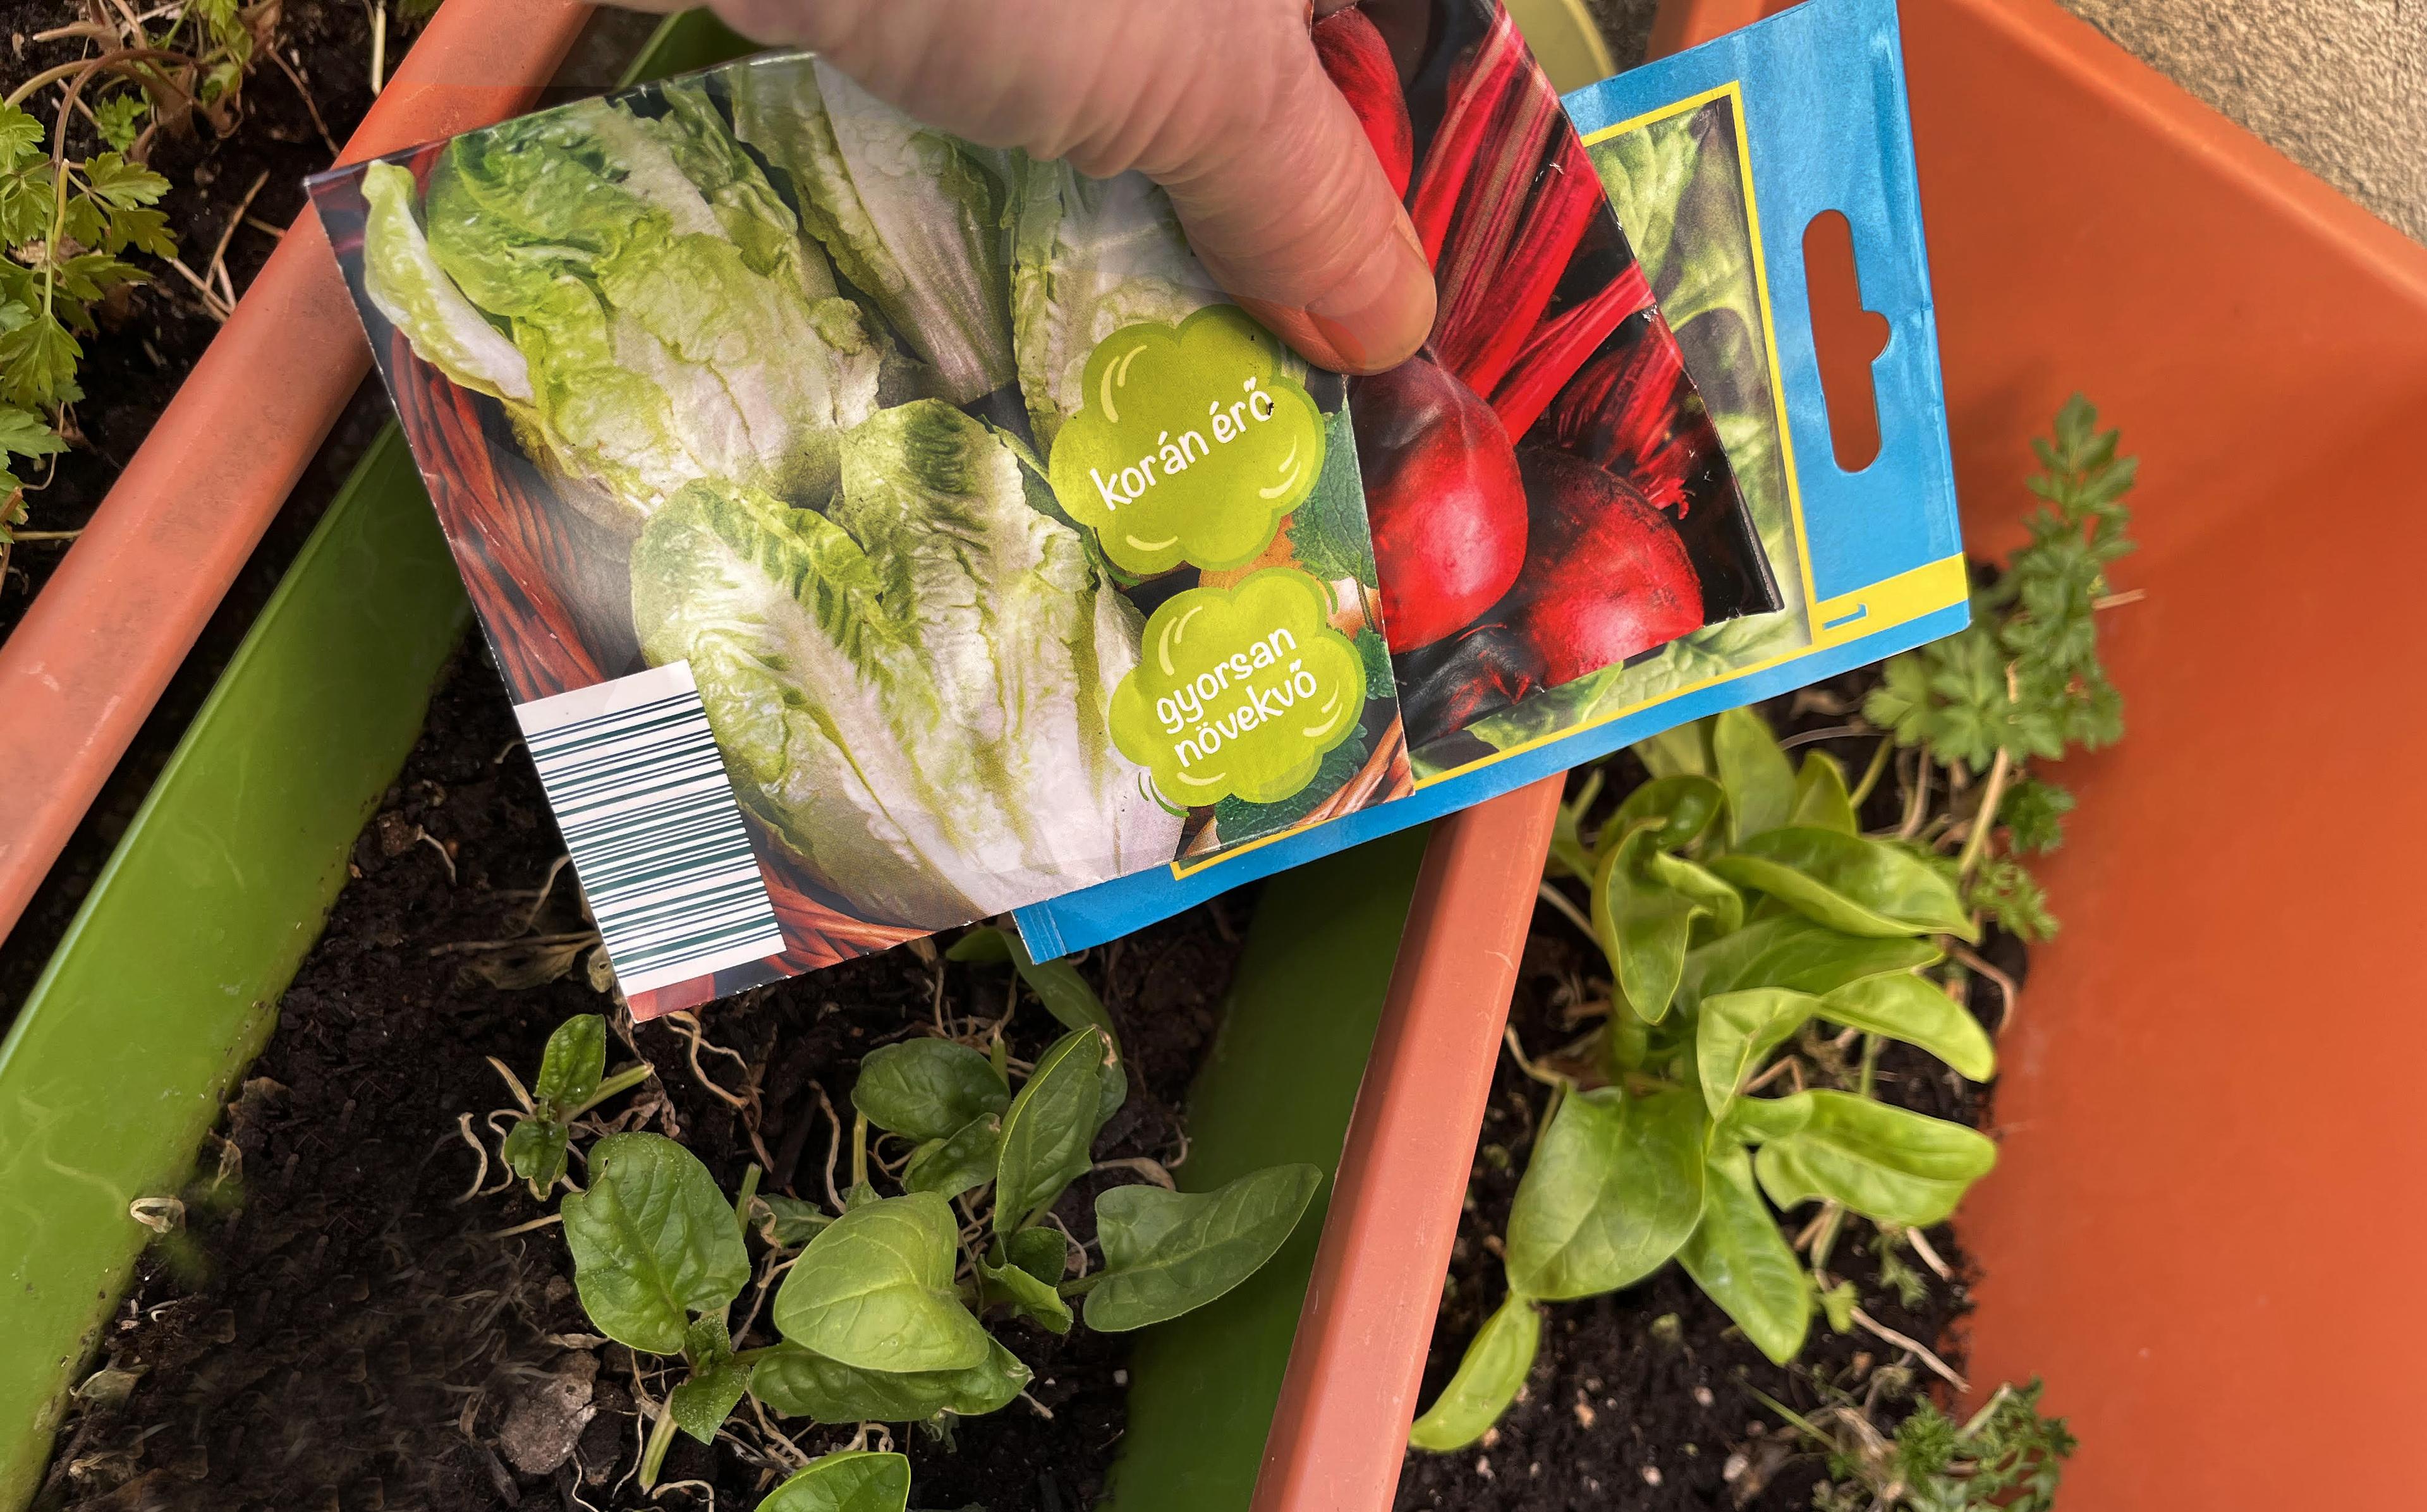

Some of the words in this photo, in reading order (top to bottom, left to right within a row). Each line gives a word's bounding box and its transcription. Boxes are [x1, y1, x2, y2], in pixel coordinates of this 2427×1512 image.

[1089, 430, 1210, 511] korán
[1209, 377, 1274, 444] érő
[1156, 628, 1297, 734] gyorsan
[1174, 658, 1317, 768] növekvő
